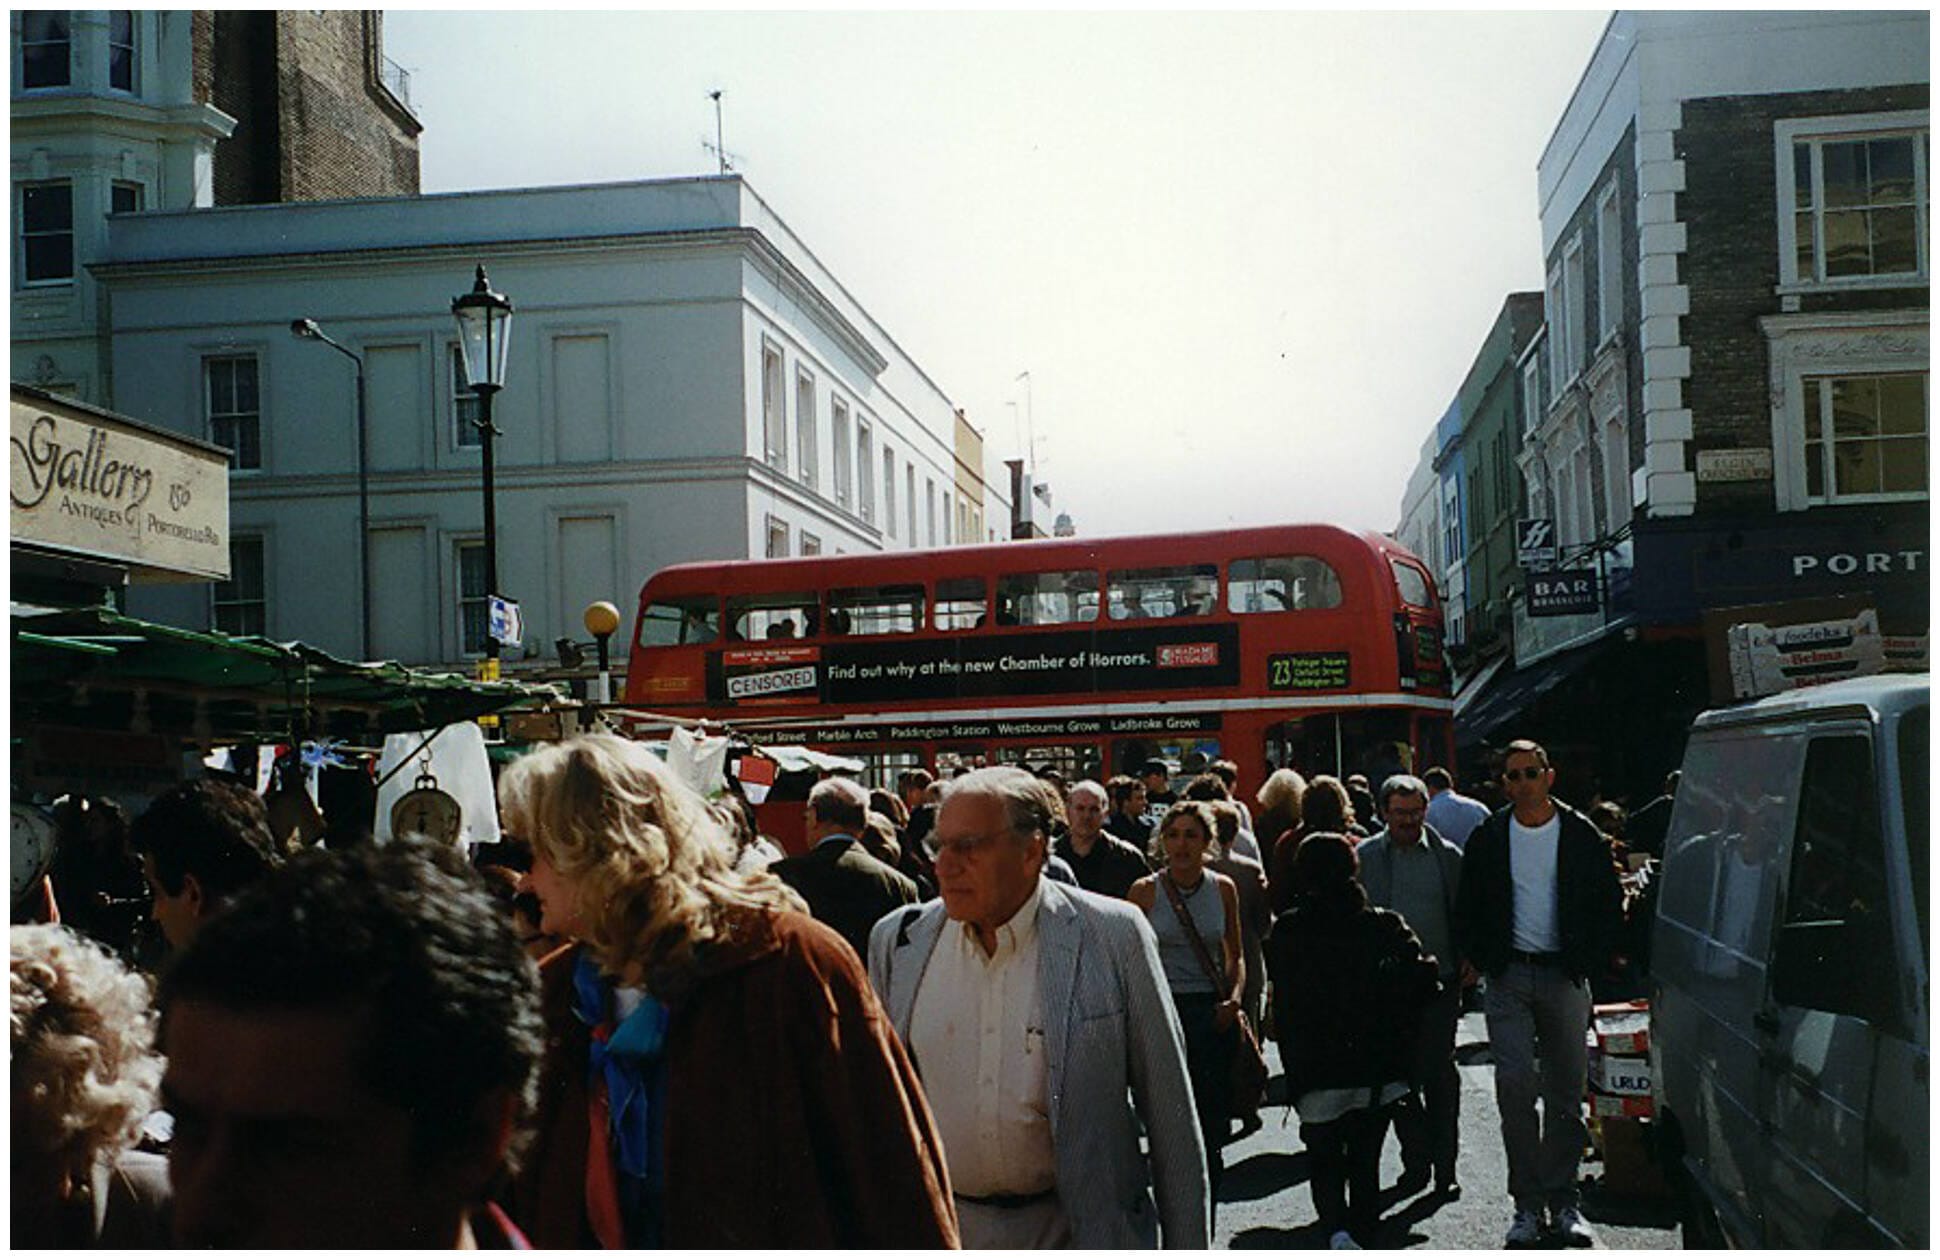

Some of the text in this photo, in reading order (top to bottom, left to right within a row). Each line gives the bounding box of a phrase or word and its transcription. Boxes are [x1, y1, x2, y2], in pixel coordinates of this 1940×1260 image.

[1793, 550, 1923, 576] PORT
[1534, 579, 1589, 596] BAR
[828, 651, 1152, 680] Find out why at the new Chamber of Horrors.
[1272, 659, 1291, 685] 23
[731, 670, 813, 694] CENSORED
[776, 731, 808, 743] Street
[817, 730, 850, 742] Marble
[853, 728, 879, 740] Arch
[890, 726, 950, 740] Paddington
[951, 724, 991, 737] Station
[998, 722, 1065, 735] Westbourne
[1066, 720, 1101, 733] Grove
[1110, 717, 1163, 731] Ladbroke
[1166, 716, 1201, 730] Grove
